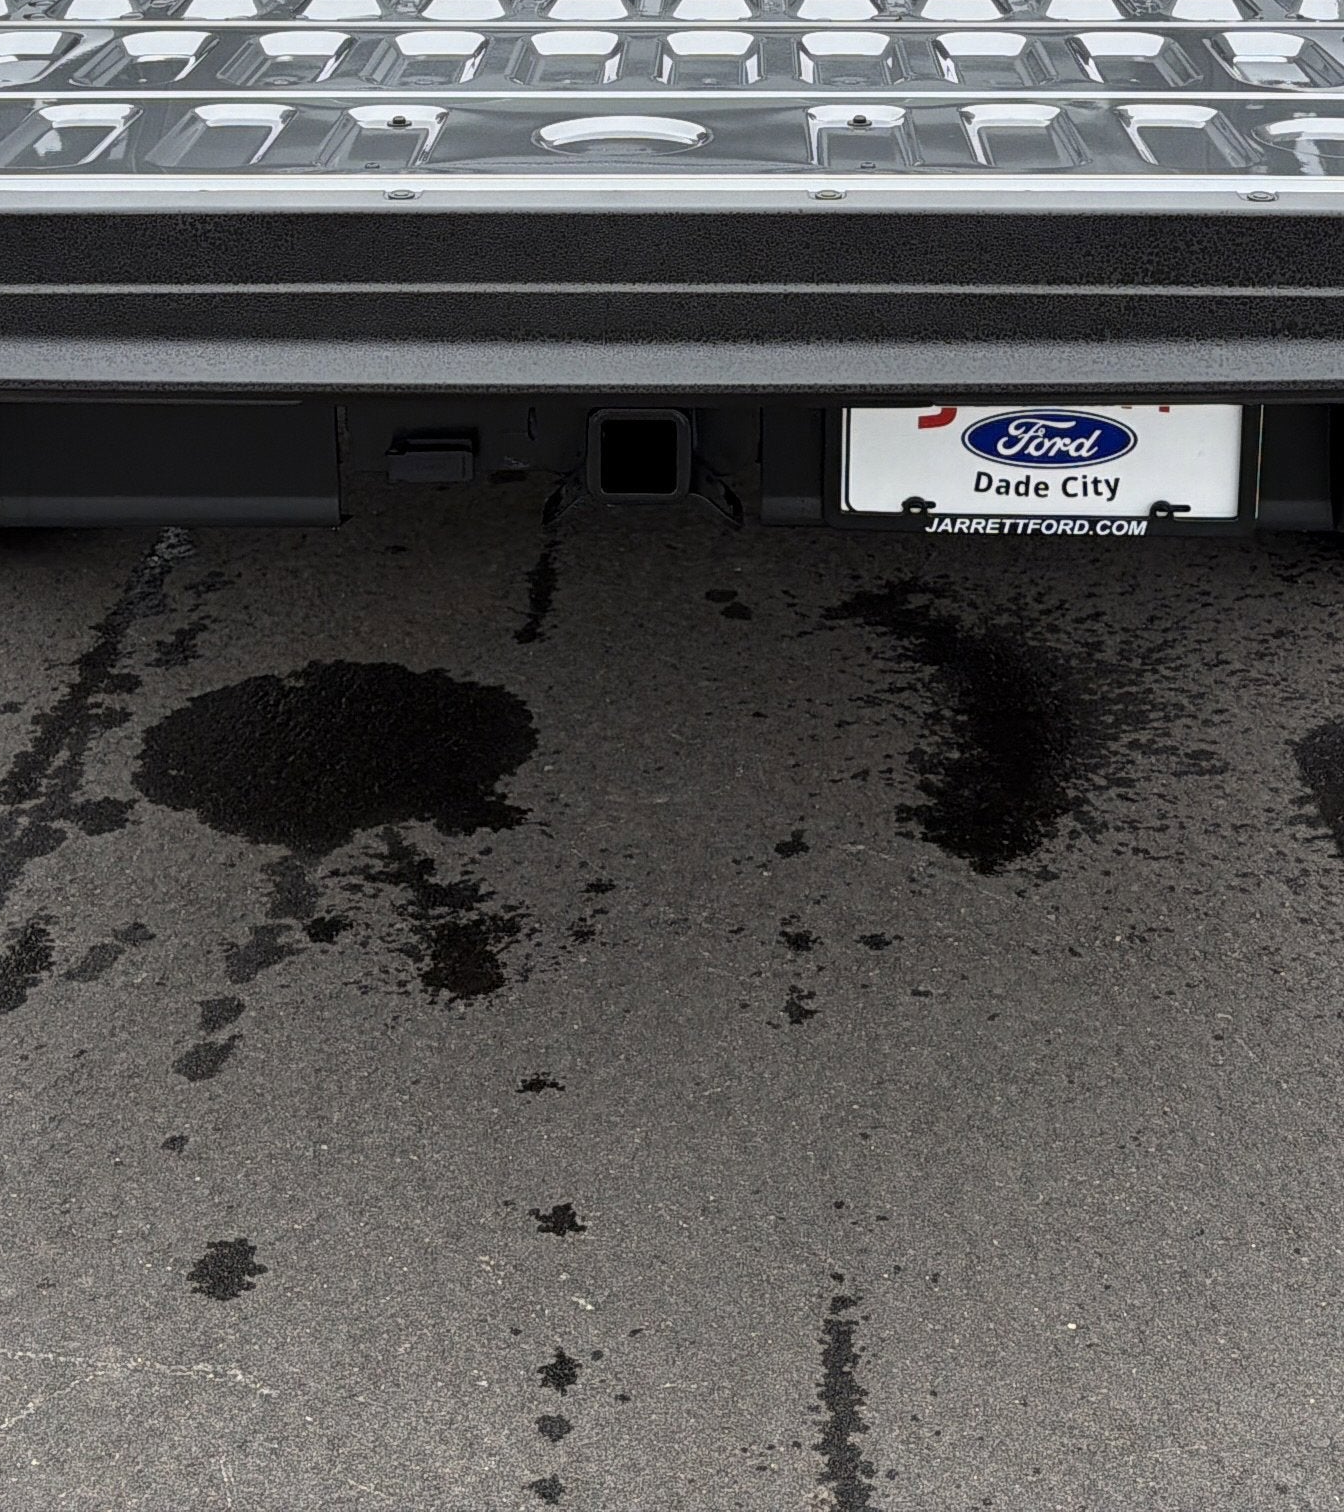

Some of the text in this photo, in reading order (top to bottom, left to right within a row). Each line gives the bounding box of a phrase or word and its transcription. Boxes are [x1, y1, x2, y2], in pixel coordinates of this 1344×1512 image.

[995, 418, 1100, 458] Ford
[973, 471, 1121, 502] Dade City
[924, 517, 1148, 536] JARRETTFORD.COM
